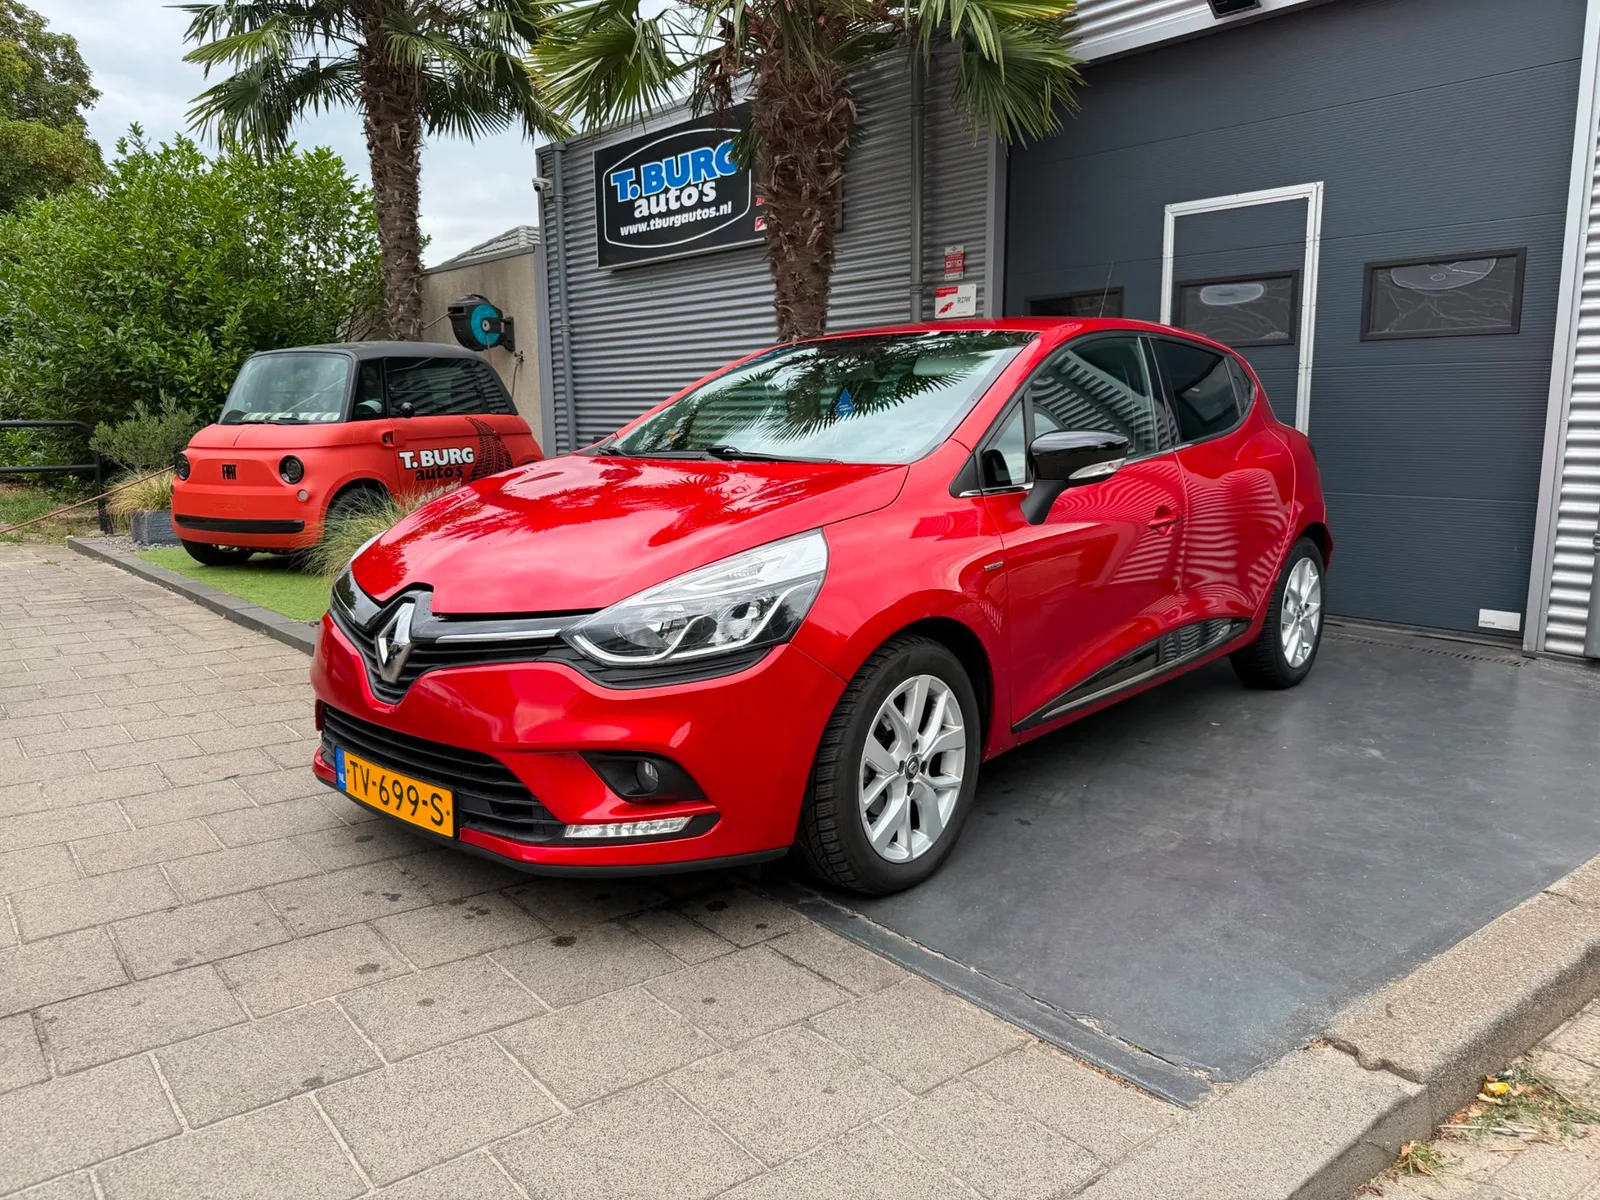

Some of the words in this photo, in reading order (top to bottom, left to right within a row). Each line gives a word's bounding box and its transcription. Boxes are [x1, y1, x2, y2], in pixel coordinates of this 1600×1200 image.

[633, 181, 717, 219] auto's
[620, 201, 732, 236] www.tburgautos.nl
[221, 463, 237, 480] FIAT
[416, 466, 464, 481] auto's
[350, 760, 444, 827] TV-699-S
